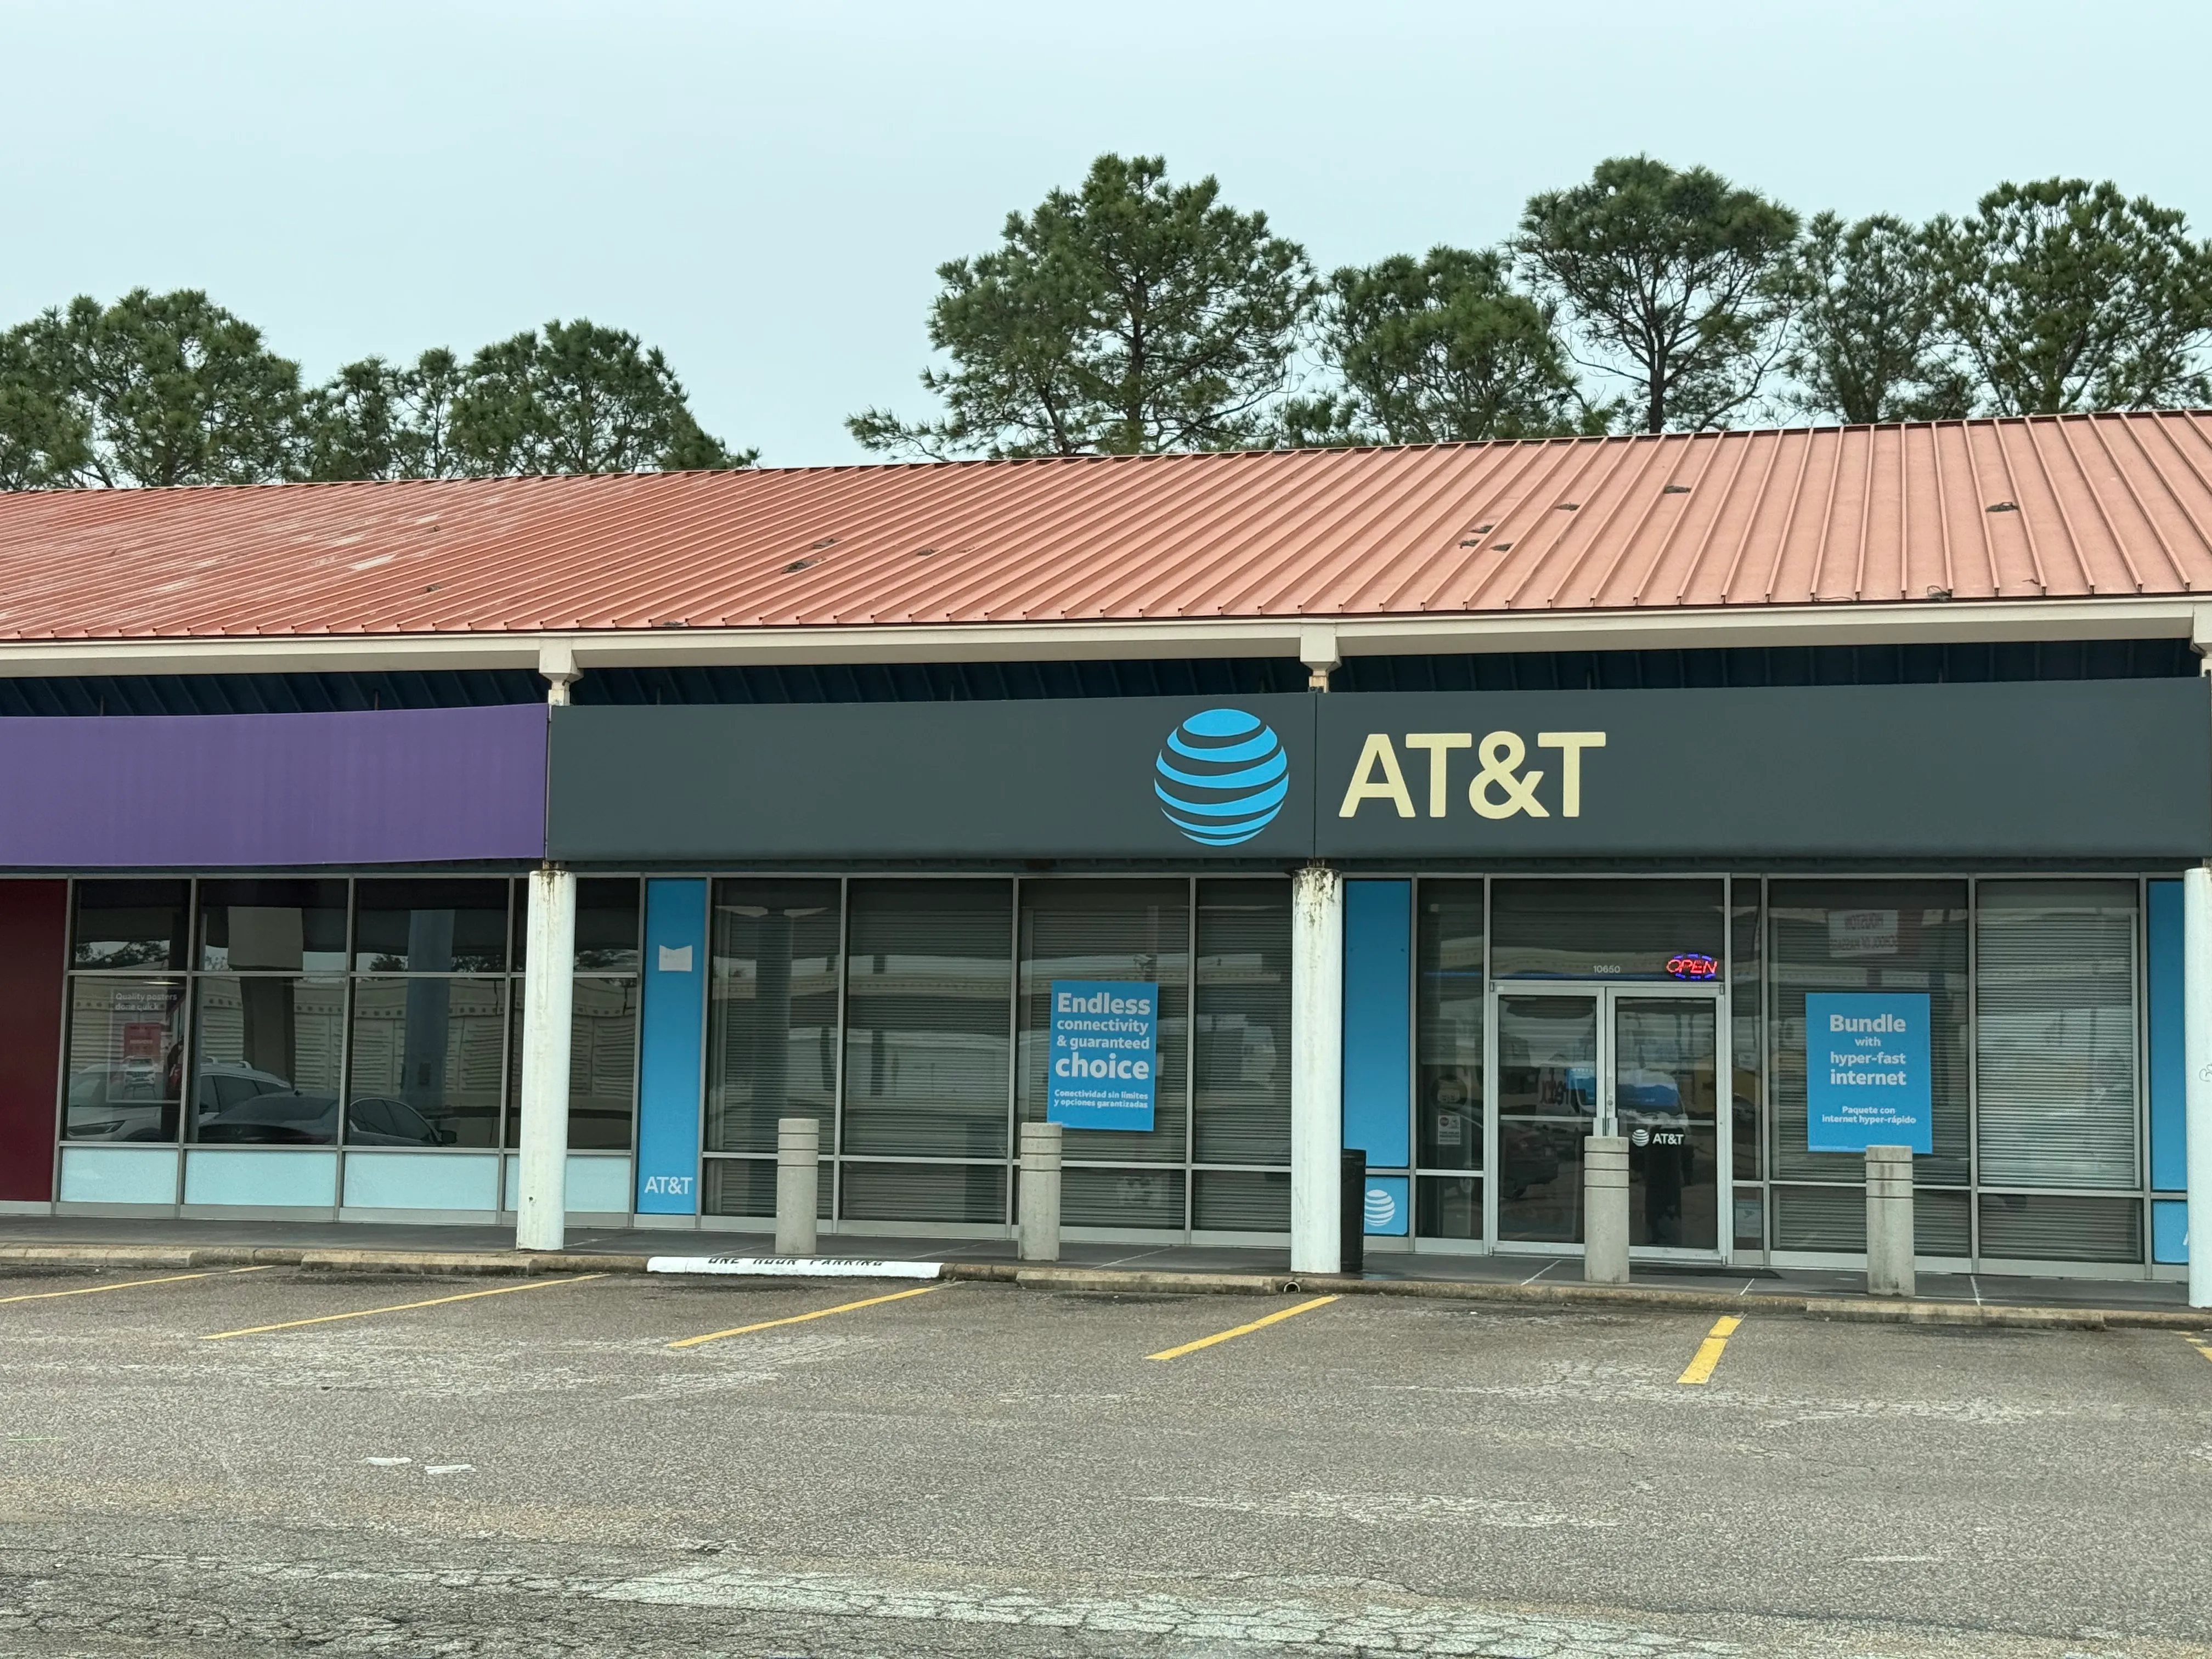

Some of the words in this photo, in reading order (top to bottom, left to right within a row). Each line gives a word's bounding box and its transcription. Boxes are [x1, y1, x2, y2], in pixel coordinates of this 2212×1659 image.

[1339, 731, 1606, 820] AT&T
[1593, 966, 1621, 974] 10650
[1666, 958, 1718, 974] OPEN
[116, 992, 145, 1003] Quality
[146, 994, 177, 1003] posters
[1058, 992, 1150, 1015] Endless
[115, 1002, 136, 1011] done
[137, 1002, 159, 1012] quick
[1057, 1018, 1149, 1036] connectivity
[1830, 1014, 1906, 1032] Bundle
[1057, 1035, 1067, 1047] &
[1070, 1036, 1150, 1050] guaranteed
[1855, 1036, 1881, 1047] with
[1056, 1052, 1149, 1080] choice
[1830, 1051, 1906, 1066] hyper-fast
[1830, 1069, 1907, 1085] internet
[1054, 1089, 1107, 1098] Conectividad
[1054, 1099, 1059, 1107] y
[1060, 1099, 1096, 1107] opciones
[1097, 1100, 1148, 1109] garantizadas
[1842, 1106, 1878, 1115] Paquete
[1652, 1133, 1685, 1146] AT&T
[644, 1176, 693, 1194] AT&T
